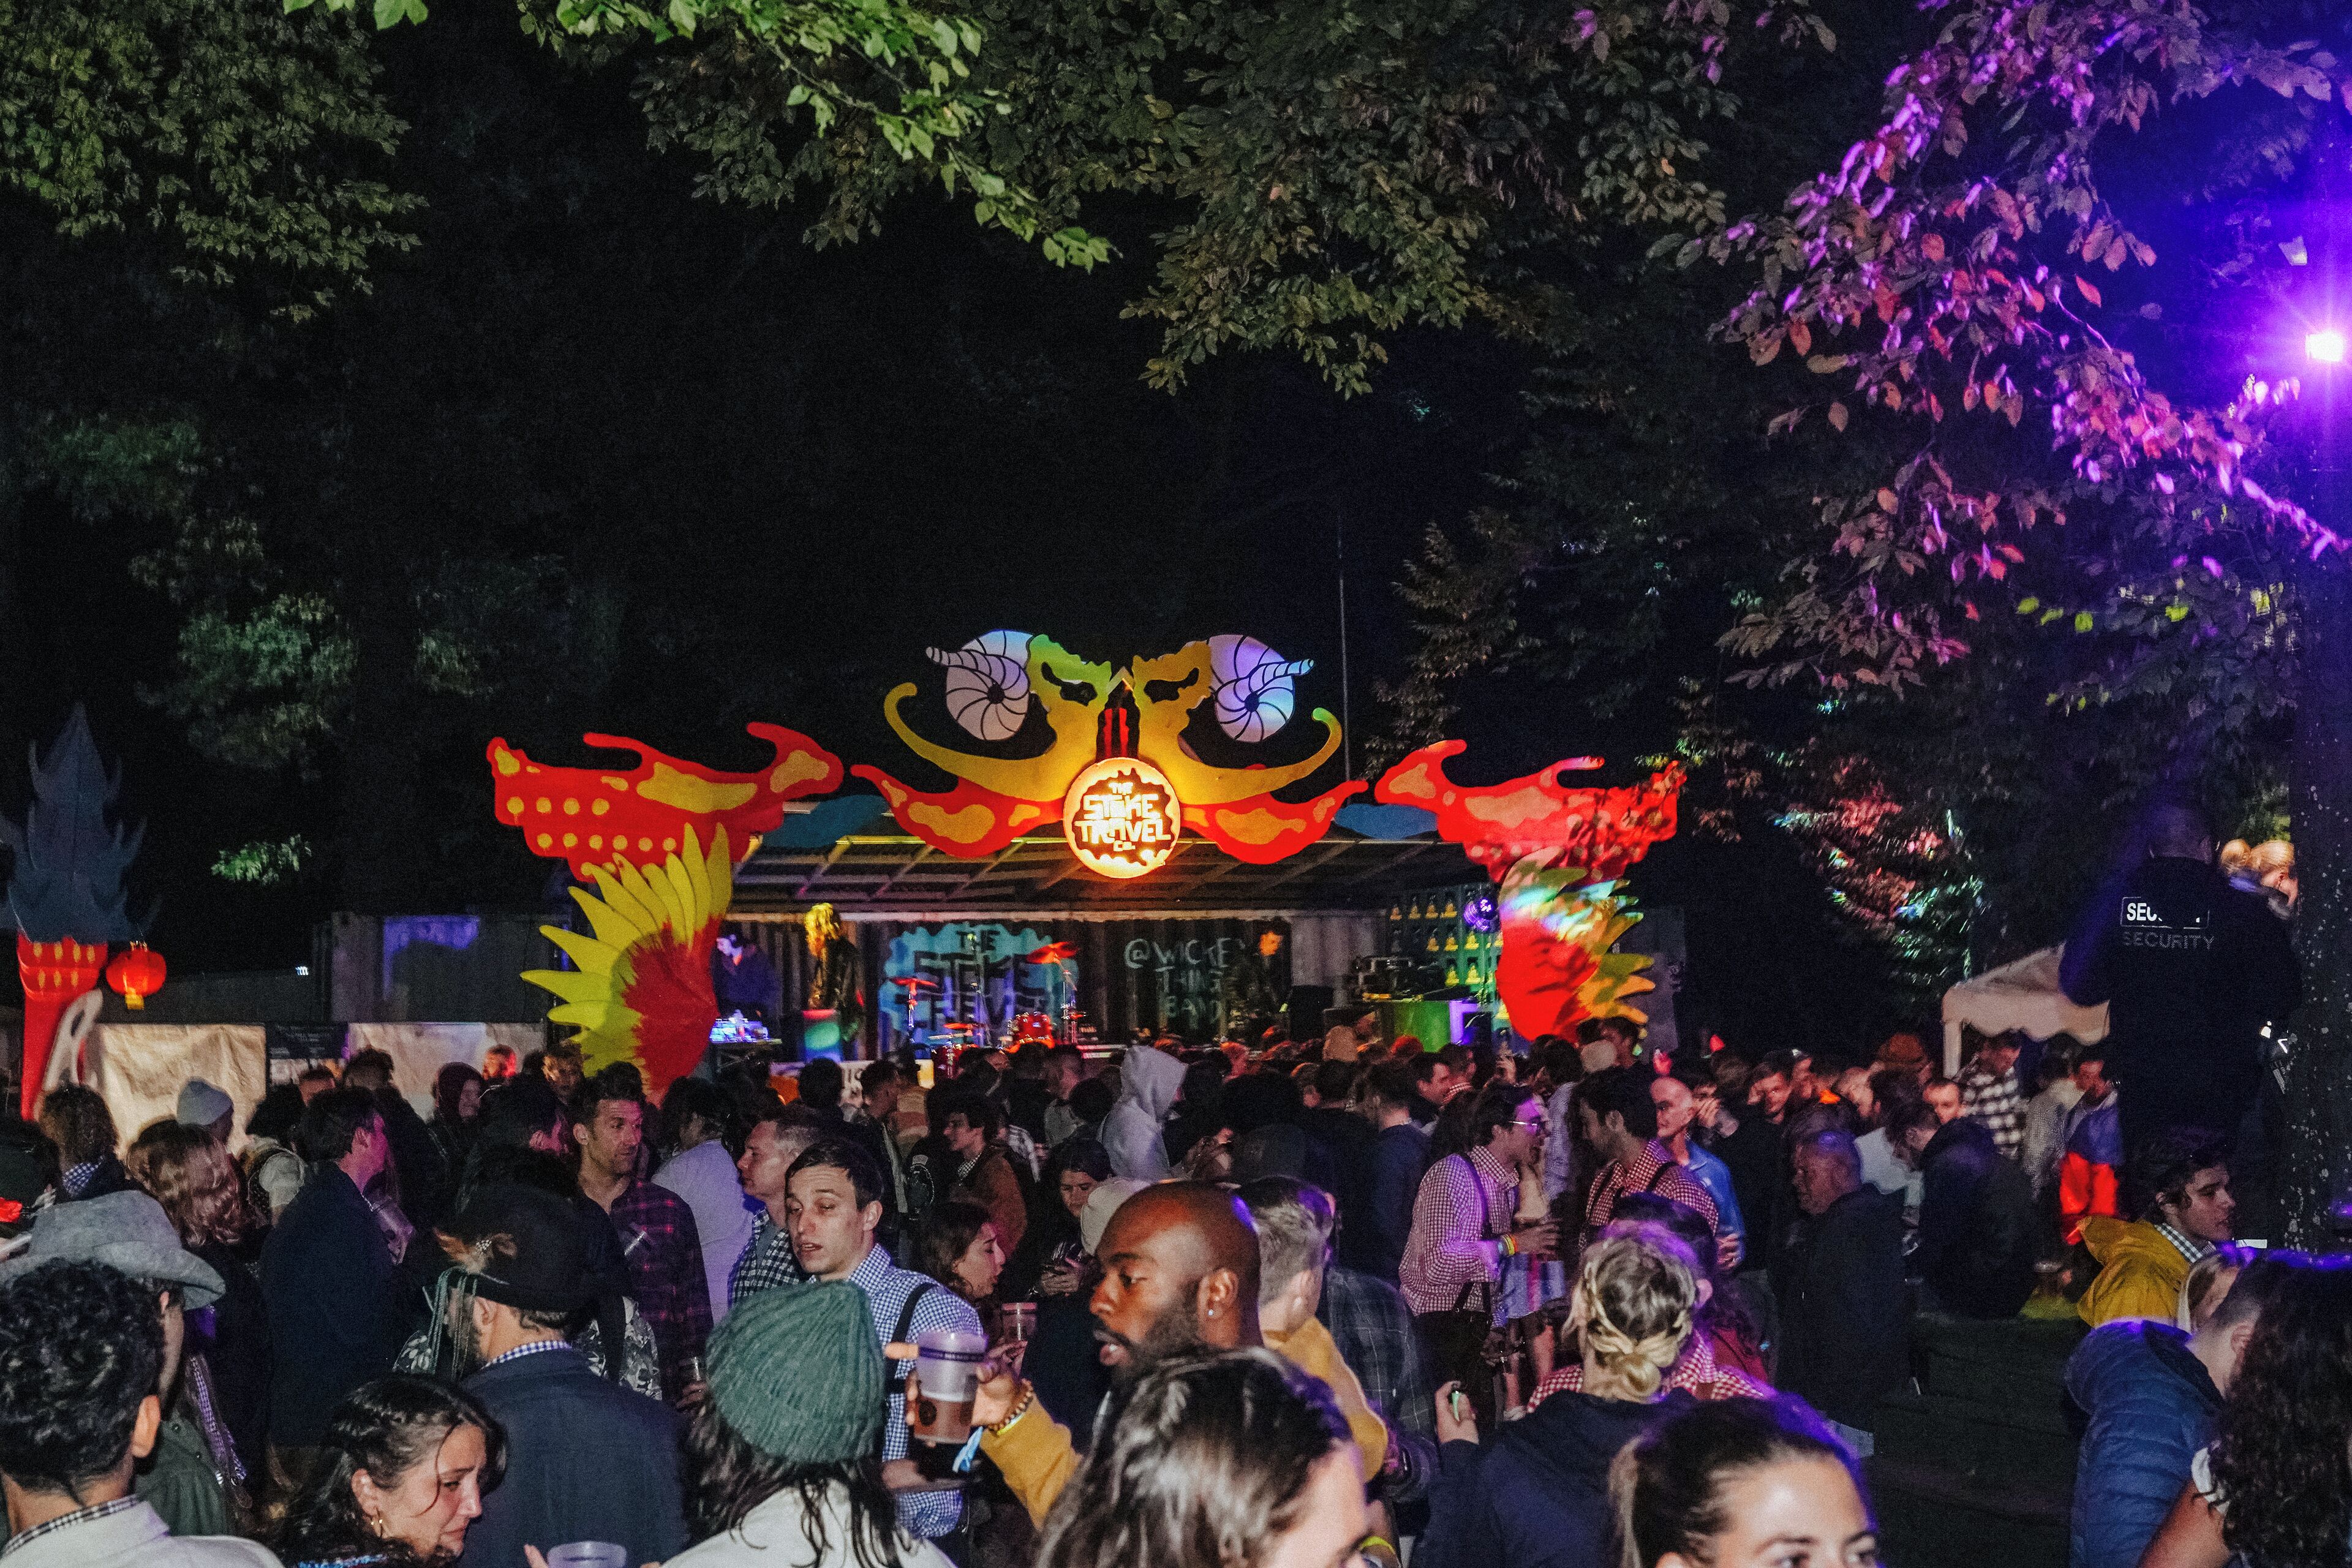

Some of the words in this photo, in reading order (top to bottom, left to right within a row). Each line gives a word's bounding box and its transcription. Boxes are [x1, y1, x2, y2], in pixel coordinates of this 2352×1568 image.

[1109, 782, 1133, 795] THE
[1084, 794, 1160, 820] STOKE
[1074, 818, 1171, 844] TRAVEL
[2122, 932, 2214, 950] SECURITY
